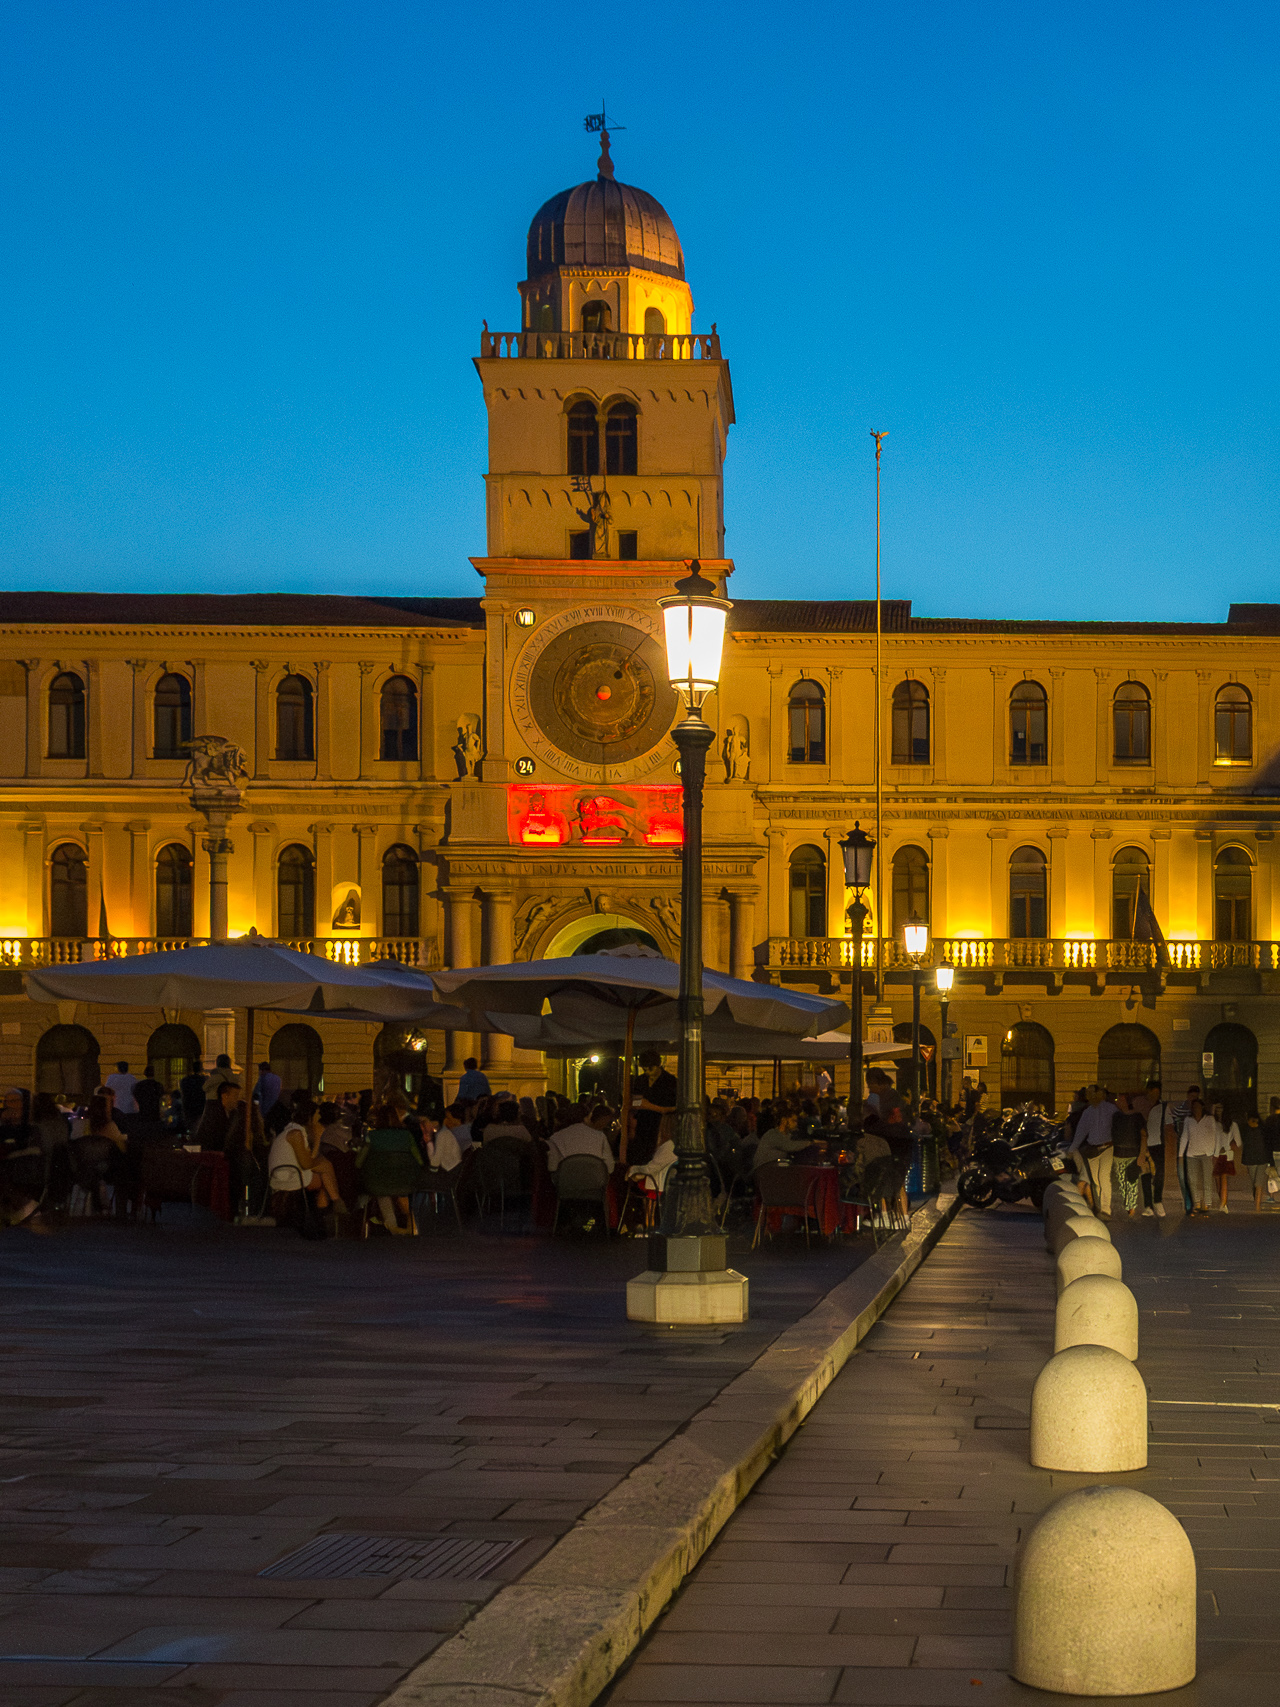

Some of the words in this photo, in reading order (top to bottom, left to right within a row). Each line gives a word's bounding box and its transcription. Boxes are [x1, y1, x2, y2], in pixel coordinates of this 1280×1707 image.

[563, 609, 582, 622] XVII
[583, 608, 603, 618] XVIII
[519, 760, 533, 774] 24
